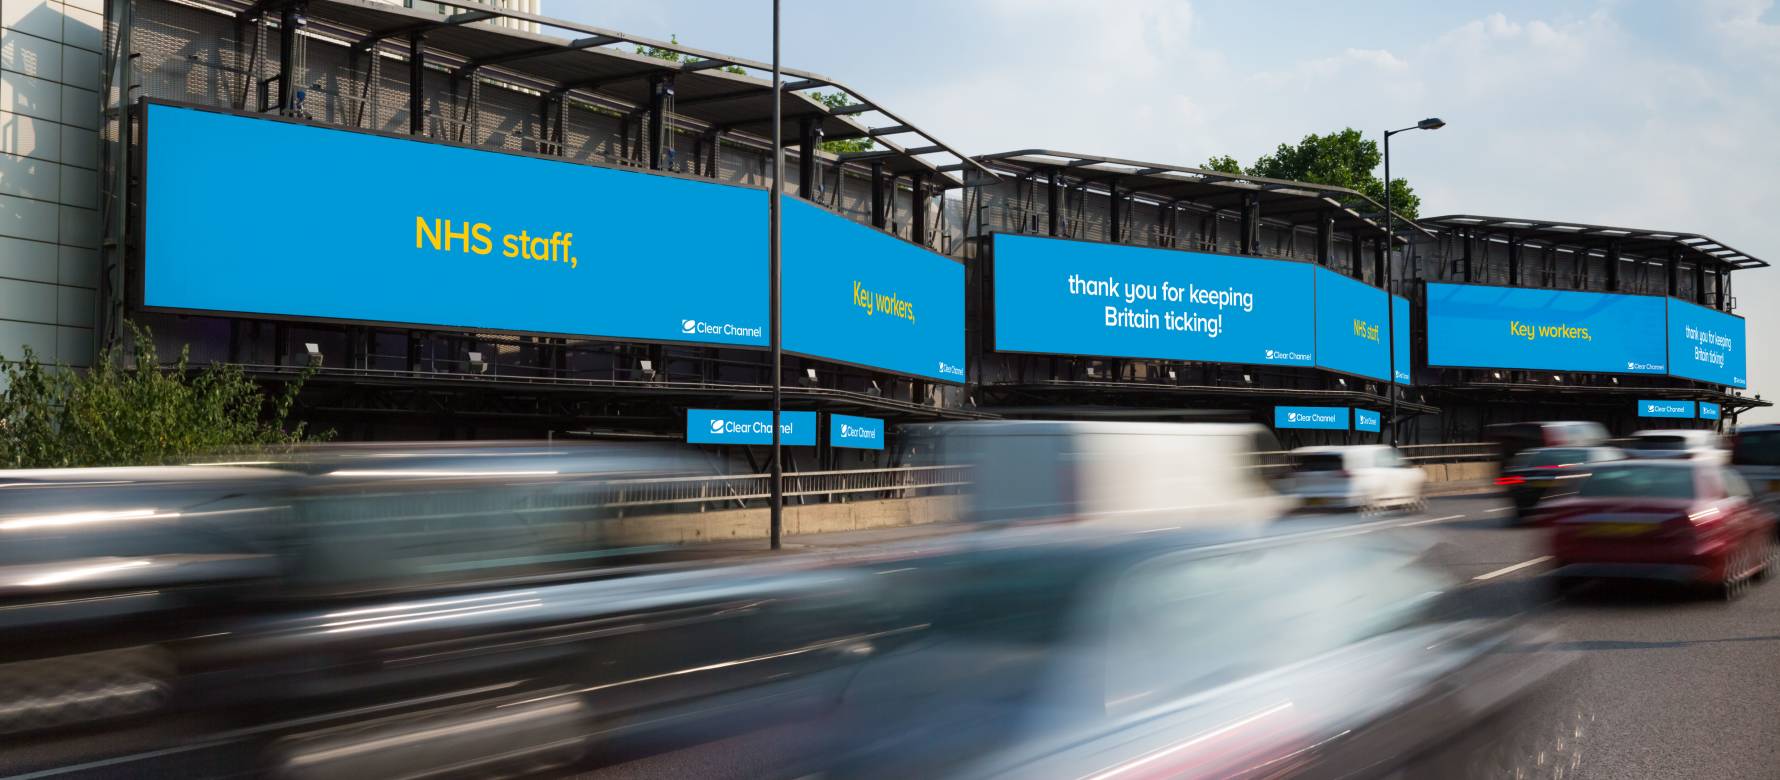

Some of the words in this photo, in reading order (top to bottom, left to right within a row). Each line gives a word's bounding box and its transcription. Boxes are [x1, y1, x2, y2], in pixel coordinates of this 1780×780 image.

[415, 215, 493, 255] NHS
[502, 229, 578, 269] staff,
[853, 280, 874, 316] Key
[875, 291, 915, 325] workers,
[1068, 274, 1119, 297] thank
[1124, 280, 1158, 304] you
[1162, 281, 1186, 302] for
[1189, 283, 1254, 312] keeping
[697, 322, 723, 335] Clear
[724, 323, 762, 338] Channel
[1105, 306, 1159, 329] Britain
[1164, 312, 1223, 338] ticking!
[1353, 319, 1367, 338] NHS
[1510, 321, 1535, 341] Key
[1538, 323, 1592, 341] workers,
[1685, 324, 1699, 340] thank
[1699, 331, 1708, 345] you
[1714, 332, 1732, 352] keeping
[1273, 351, 1288, 359] Clear
[1289, 351, 1312, 361] Channel
[1694, 346, 1709, 363] Britain
[725, 421, 751, 433] Clear
[752, 421, 793, 434] Chanel
[1296, 413, 1311, 422] Clear
[1312, 413, 1336, 423] Channel
[847, 426, 859, 437] Clear
[859, 427, 876, 439] Channel
